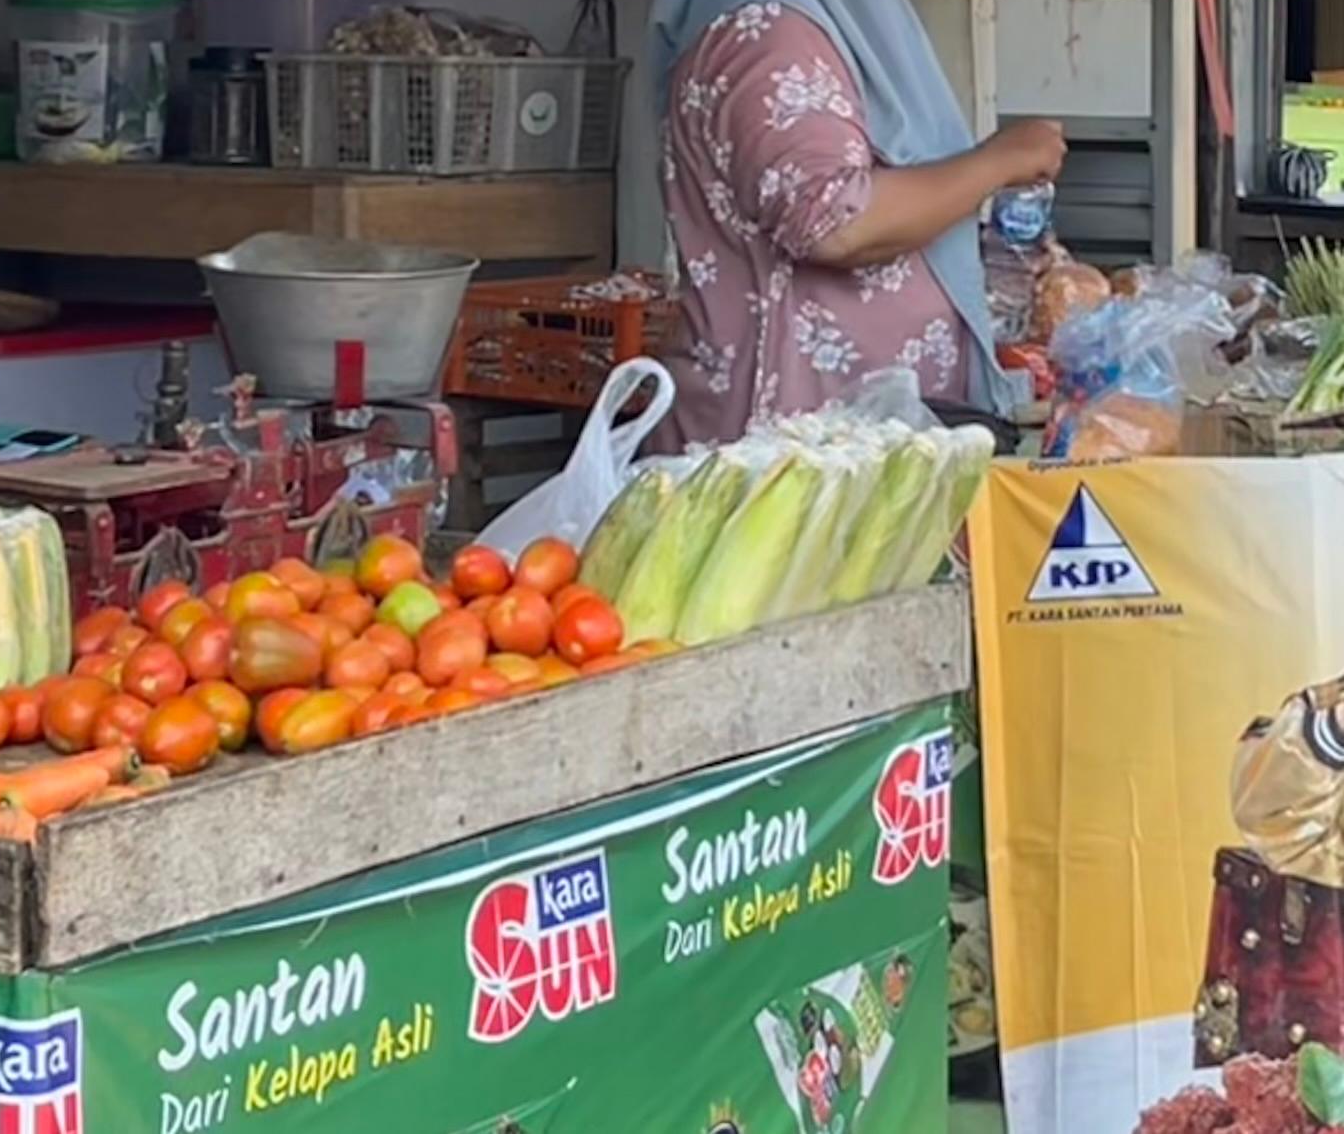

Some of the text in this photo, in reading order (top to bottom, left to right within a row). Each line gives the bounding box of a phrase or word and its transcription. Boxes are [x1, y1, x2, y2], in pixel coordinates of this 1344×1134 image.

[539, 862, 599, 920] kara
[660, 805, 809, 903] Santan
[664, 850, 852, 964] Dari Kelapa Asli
[158, 951, 367, 1072] Santan
[466, 874, 617, 1043] SUN
[160, 1004, 434, 1134] Dari Kelapa Asli
